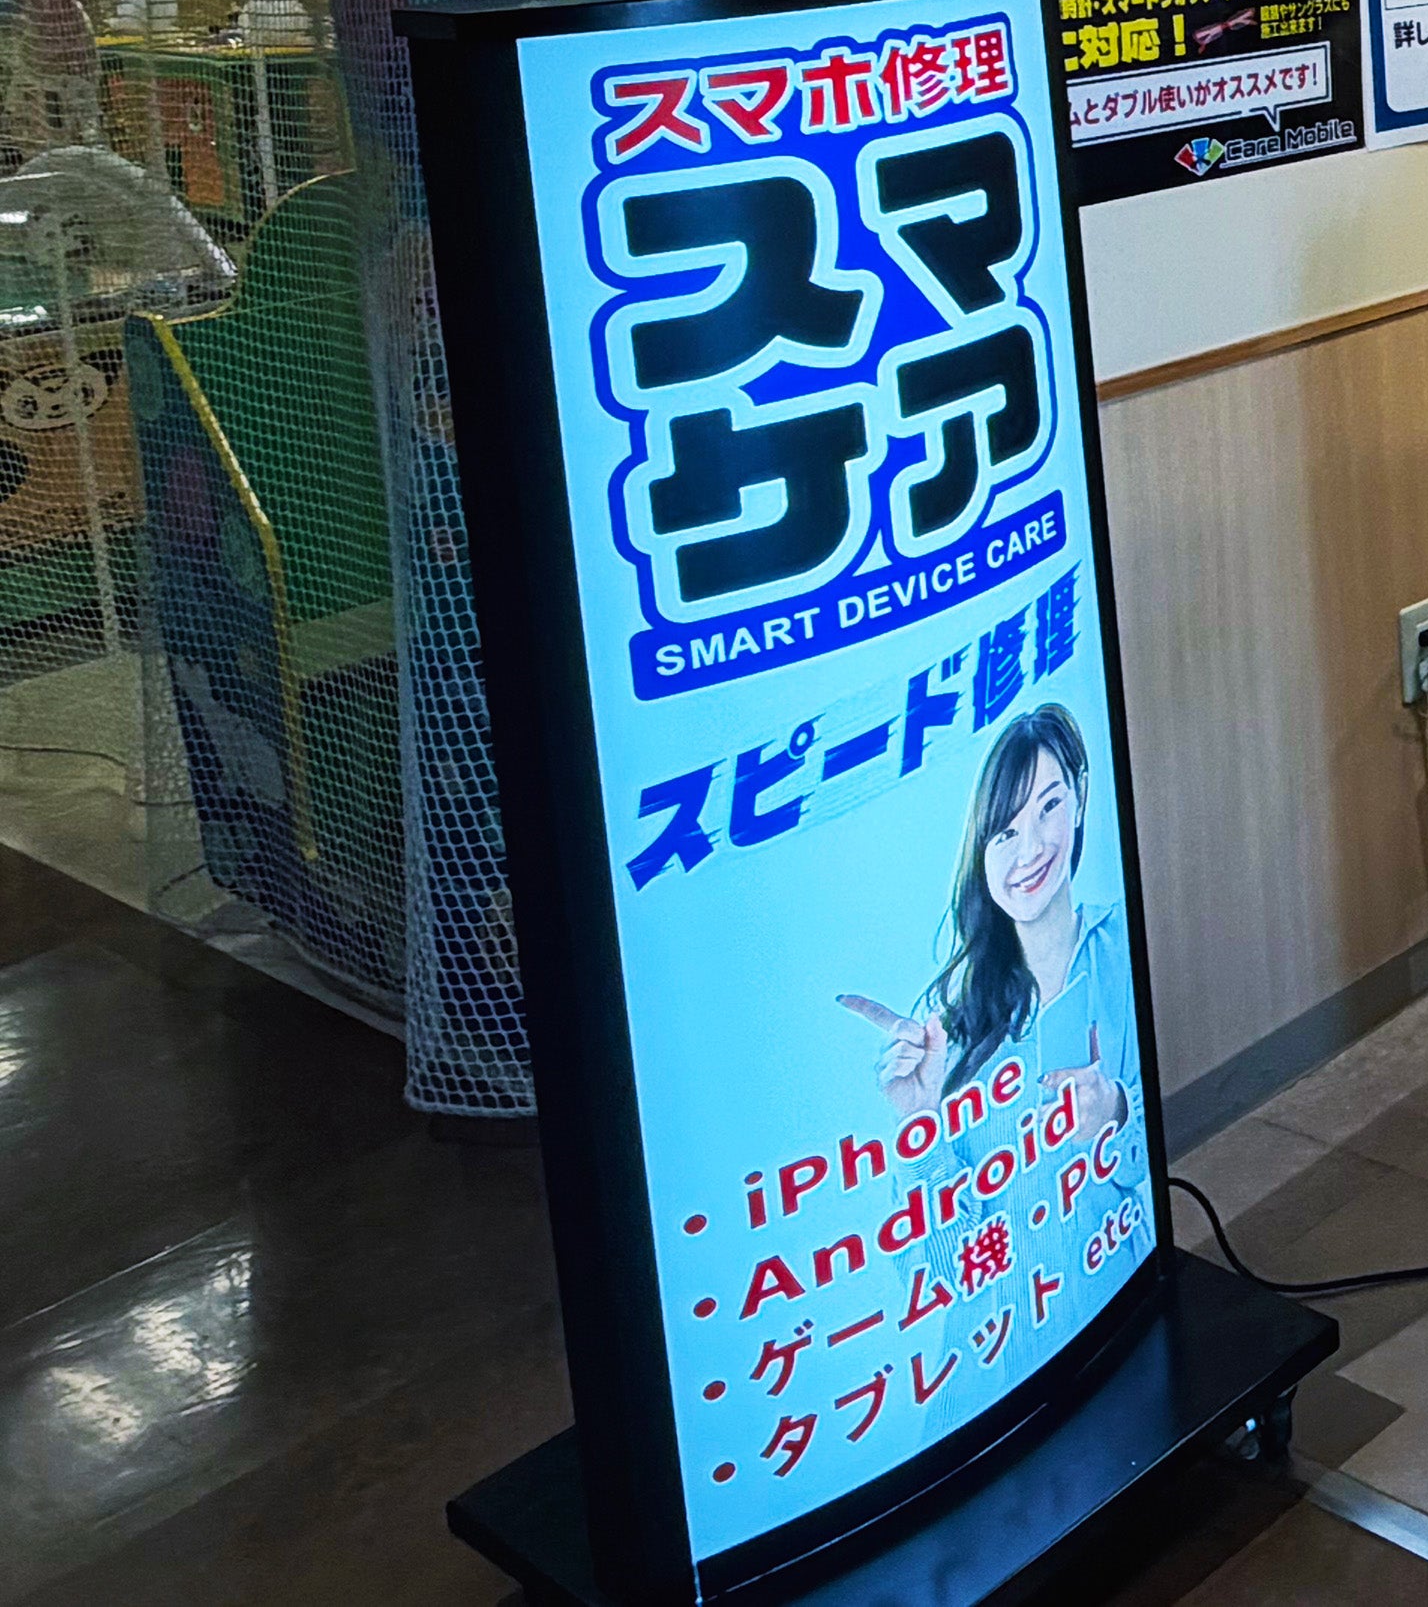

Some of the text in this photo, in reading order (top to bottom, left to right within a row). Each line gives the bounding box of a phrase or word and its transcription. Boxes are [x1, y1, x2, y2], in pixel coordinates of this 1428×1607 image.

[610, 26, 1012, 159] スマホ修理
[1225, 119, 1354, 162] Care Mobile
[655, 512, 1059, 677] SMART DEVICE CARE
[626, 561, 1082, 891] スピード修理
